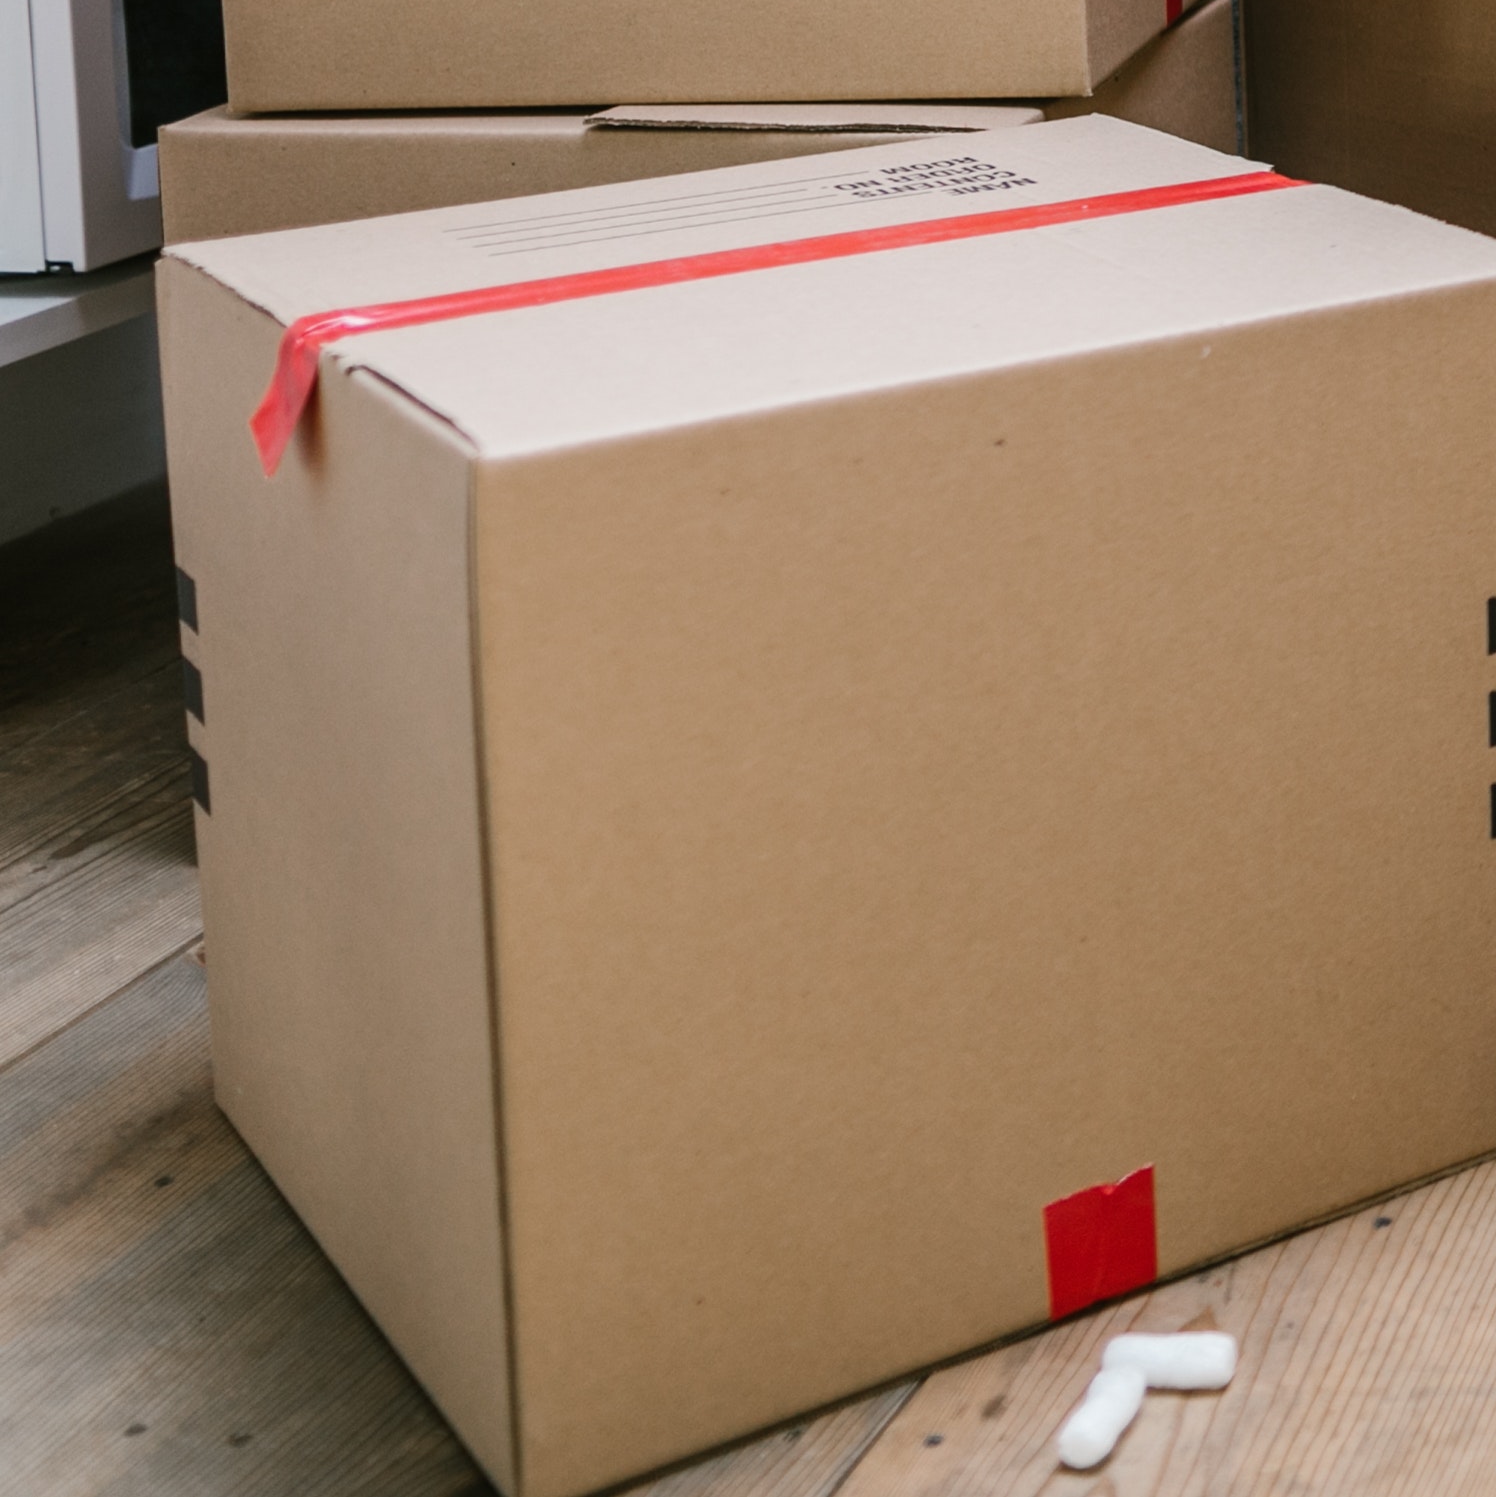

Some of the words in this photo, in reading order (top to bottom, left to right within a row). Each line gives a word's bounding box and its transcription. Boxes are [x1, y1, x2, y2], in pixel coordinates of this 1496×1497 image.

[880, 156, 978, 175] ROOM
[887, 163, 997, 183] ORDER
[851, 170, 1016, 198] CONTENTS
